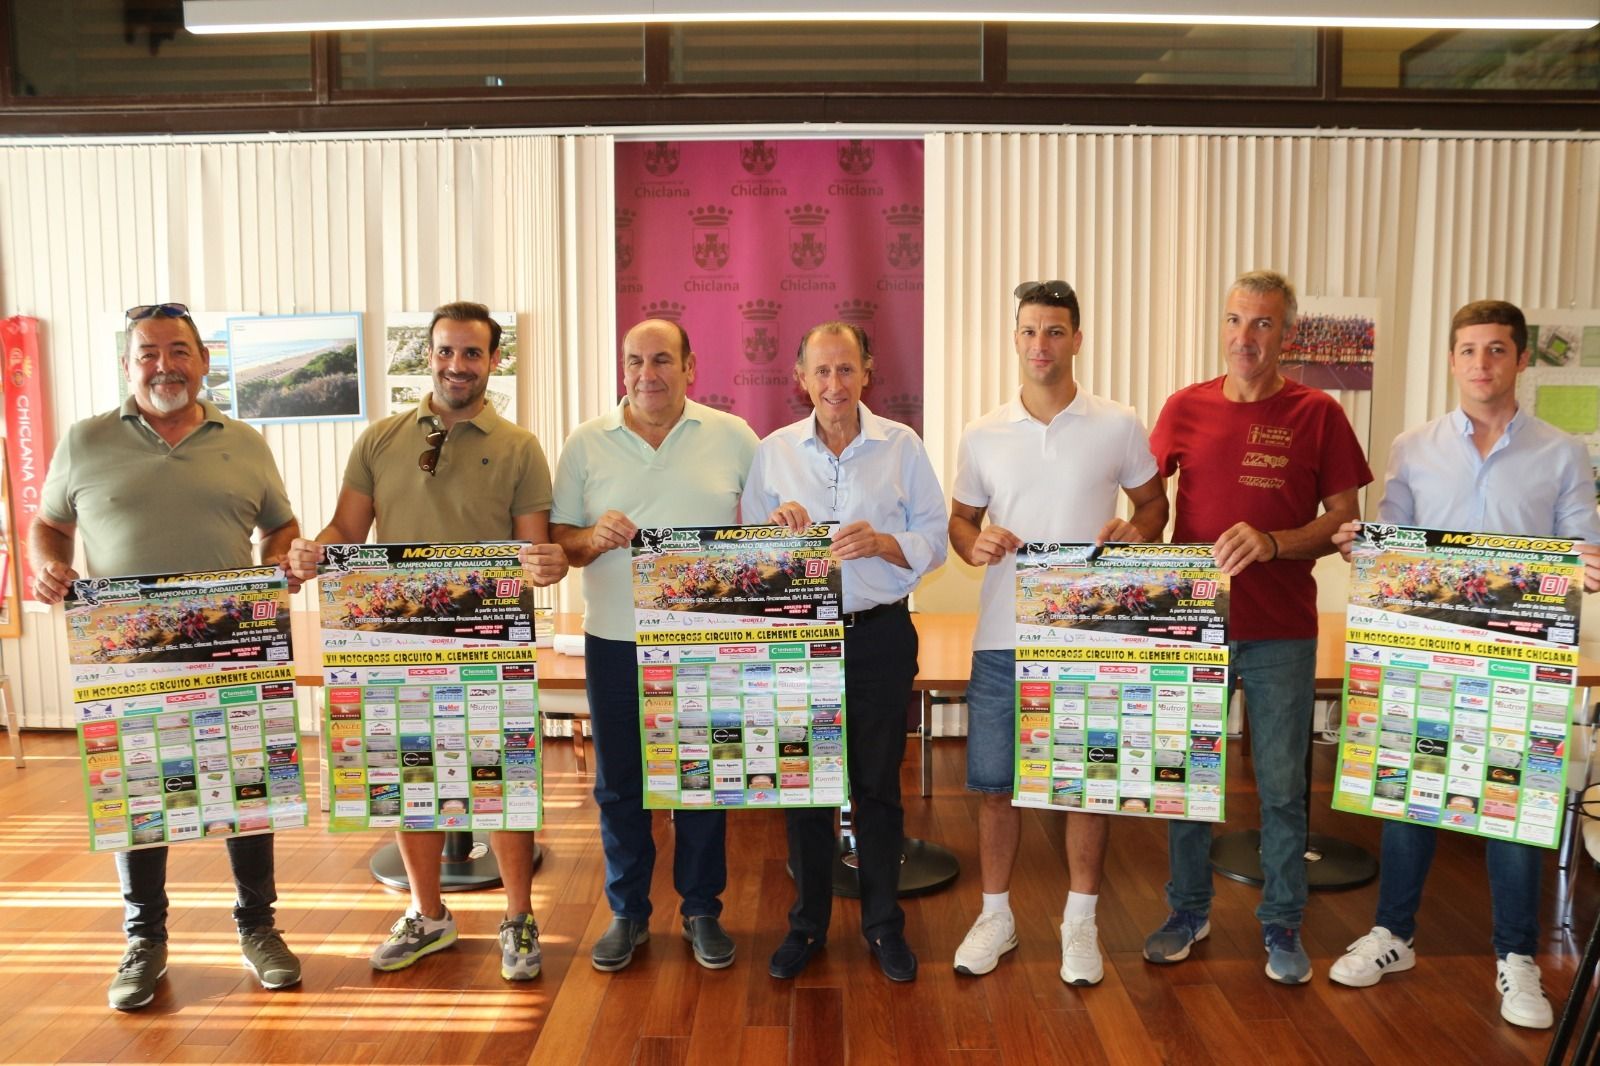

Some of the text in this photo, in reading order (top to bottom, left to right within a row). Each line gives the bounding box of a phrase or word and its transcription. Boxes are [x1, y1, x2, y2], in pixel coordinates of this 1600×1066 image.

[634, 186, 690, 198] Chiclana
[731, 184, 788, 197] Chiclana
[828, 184, 884, 197] Chiclana
[684, 280, 740, 292] Chiclana
[780, 279, 836, 292] Chiclana
[734, 374, 788, 386] Chiclana
[16, 395, 34, 482] CHICLANA
[1442, 532, 1574, 552] MOTOCROSS
[402, 545, 521, 558] MOTOCROSS
[1434, 546, 1484, 555] CAMPEONATO
[804, 558, 829, 577] 01
[154, 568, 276, 585] MOTOCROSS
[496, 578, 521, 597] 01
[1191, 580, 1218, 599] 01
[1538, 574, 1569, 596] 01
[148, 588, 196, 598] CAMPEONATO
[1522, 593, 1565, 603] OCTUBRE
[251, 600, 277, 620] 01
[238, 619, 276, 628] OCTUBRE
[639, 628, 839, 643] VII MOTOCROSS CIRCUITO M. CLEMENTE CHICLANA
[1349, 630, 1360, 639] VII
[1363, 632, 1416, 645] MOTOCROSS
[1418, 637, 1461, 650] CIRCUITO
[1464, 642, 1474, 651] M.
[1476, 643, 1523, 656] CLEMENTE
[1525, 649, 1573, 662] CHICLANA
[325, 650, 532, 663] VII MOTOCROSS CIRCUITO M. CLEMENTE CHICLANA
[1019, 649, 1224, 661] VII MOTOCROSS CIRCUITO M. CLEMENTE CHICLANA
[76, 673, 100, 681] FAM
[78, 668, 291, 699] VII MOTOCROSS CIRCUITO M. CLEMENTE CHICLANA
[168, 693, 205, 702] ROMERO
[221, 689, 253, 698] Clemente
